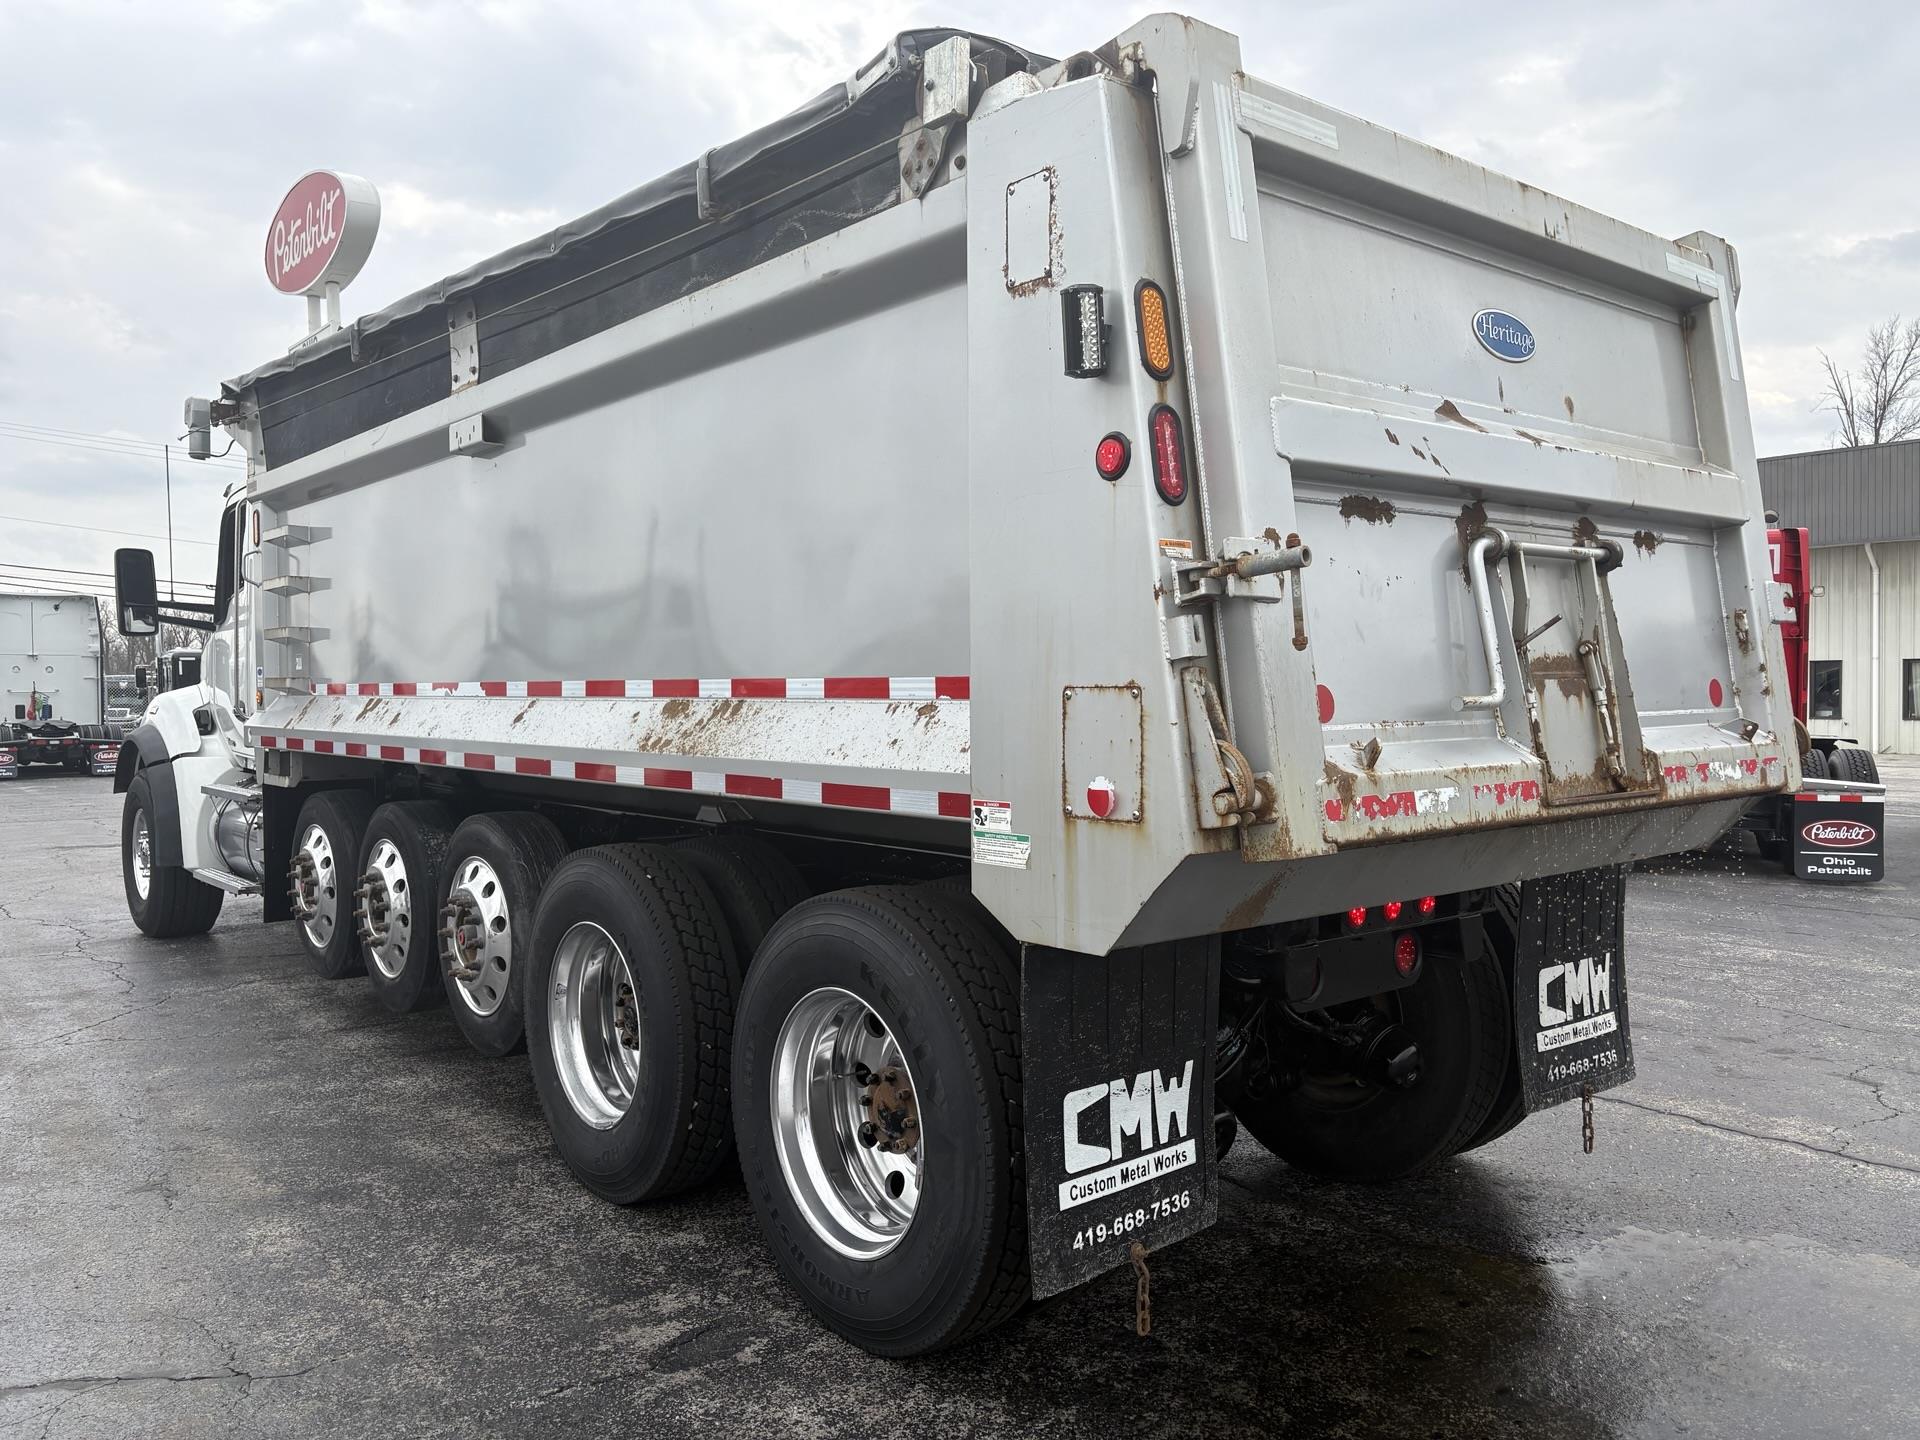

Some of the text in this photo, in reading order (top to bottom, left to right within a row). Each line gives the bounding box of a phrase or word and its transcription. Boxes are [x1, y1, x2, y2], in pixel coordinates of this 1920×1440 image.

[274, 188, 340, 284] Peterbilt
[1479, 314, 1534, 354] Heritage
[1812, 825, 1870, 840] Peterbilt
[1807, 866, 1872, 876] Peterbilt
[1823, 857, 1856, 866] Ohio
[1539, 952, 1611, 1028] CMW
[1543, 1019, 1612, 1047] Custom Metal Works
[1547, 1049, 1618, 1082] 419-668-7536
[1063, 1059, 1194, 1175] CMW
[1069, 1149, 1188, 1201] Custom Metal Works
[1072, 1190, 1190, 1251] 419-668-7536
